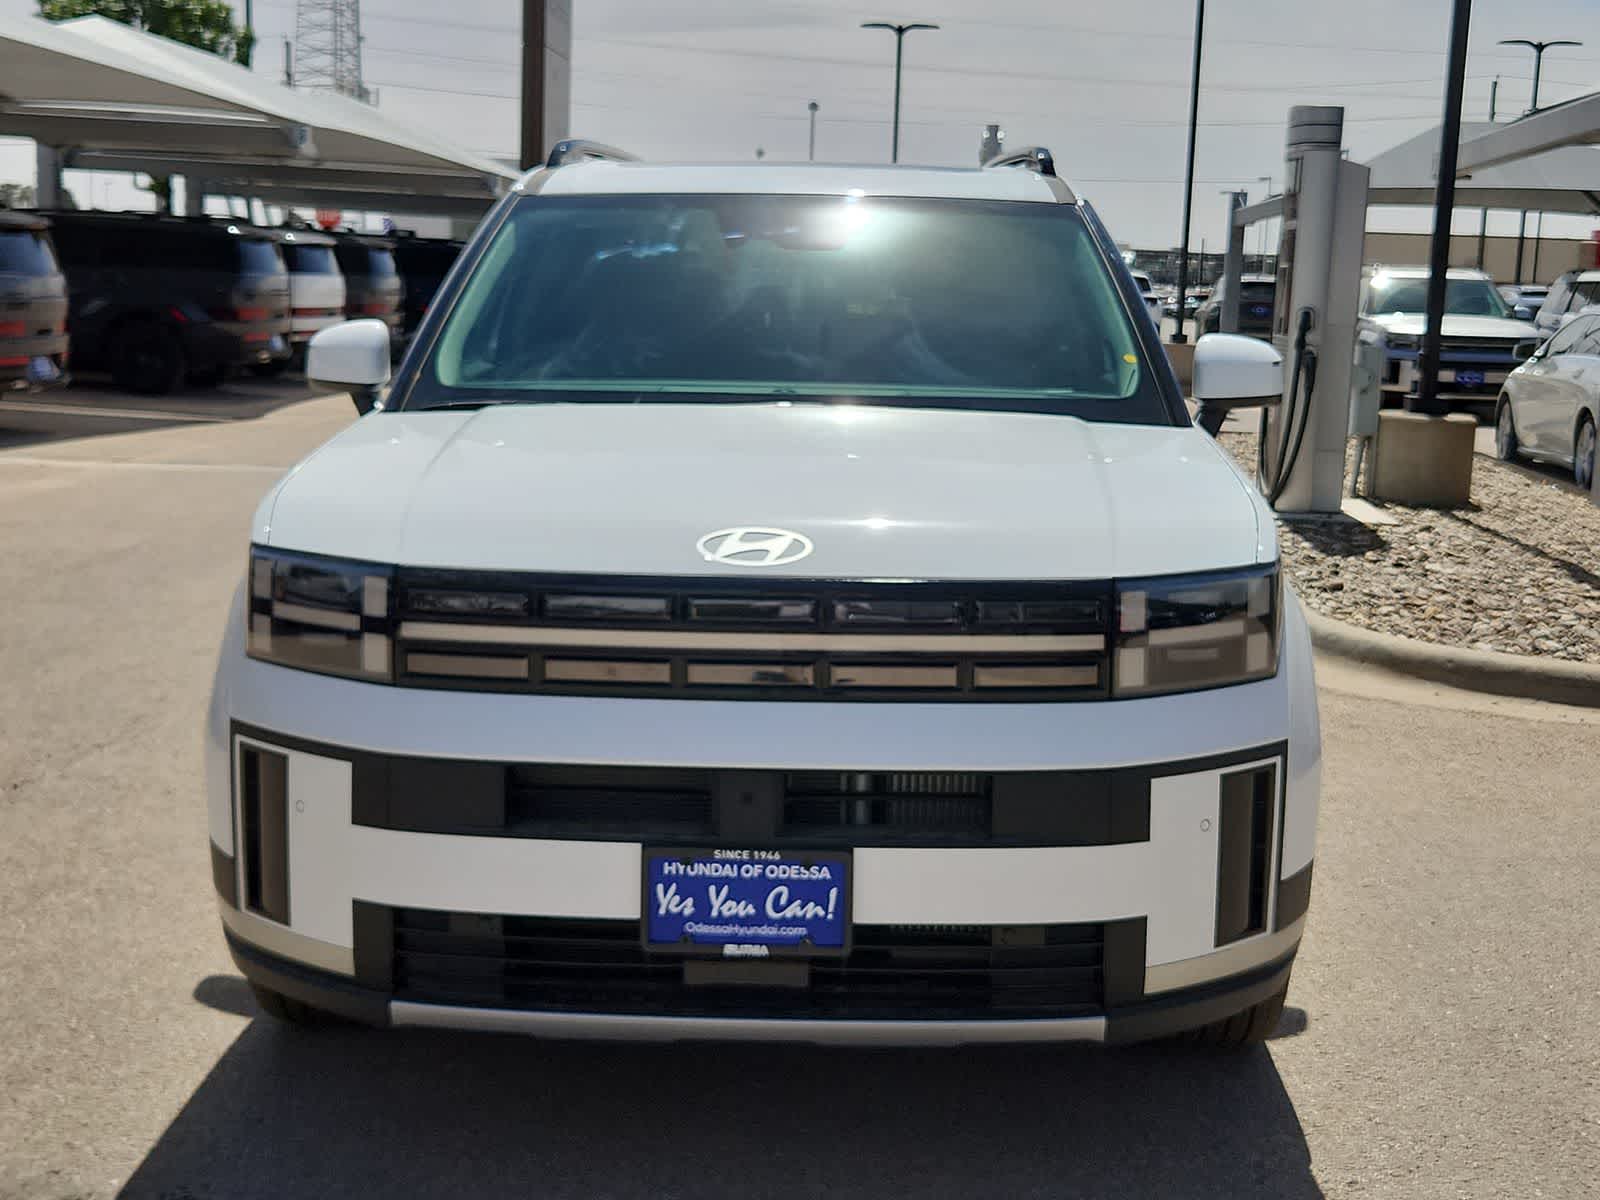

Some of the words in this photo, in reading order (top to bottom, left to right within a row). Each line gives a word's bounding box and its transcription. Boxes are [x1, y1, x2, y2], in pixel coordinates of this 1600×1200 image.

[713, 849, 749, 860] SINCE
[663, 862, 738, 877] HYUNDAI
[740, 864, 764, 878] OF
[765, 865, 832, 880] ODESSA
[656, 882, 695, 916] Yes
[708, 884, 756, 917] You
[765, 885, 838, 919] Can!
[684, 921, 808, 937] OdessaHyundai.com
